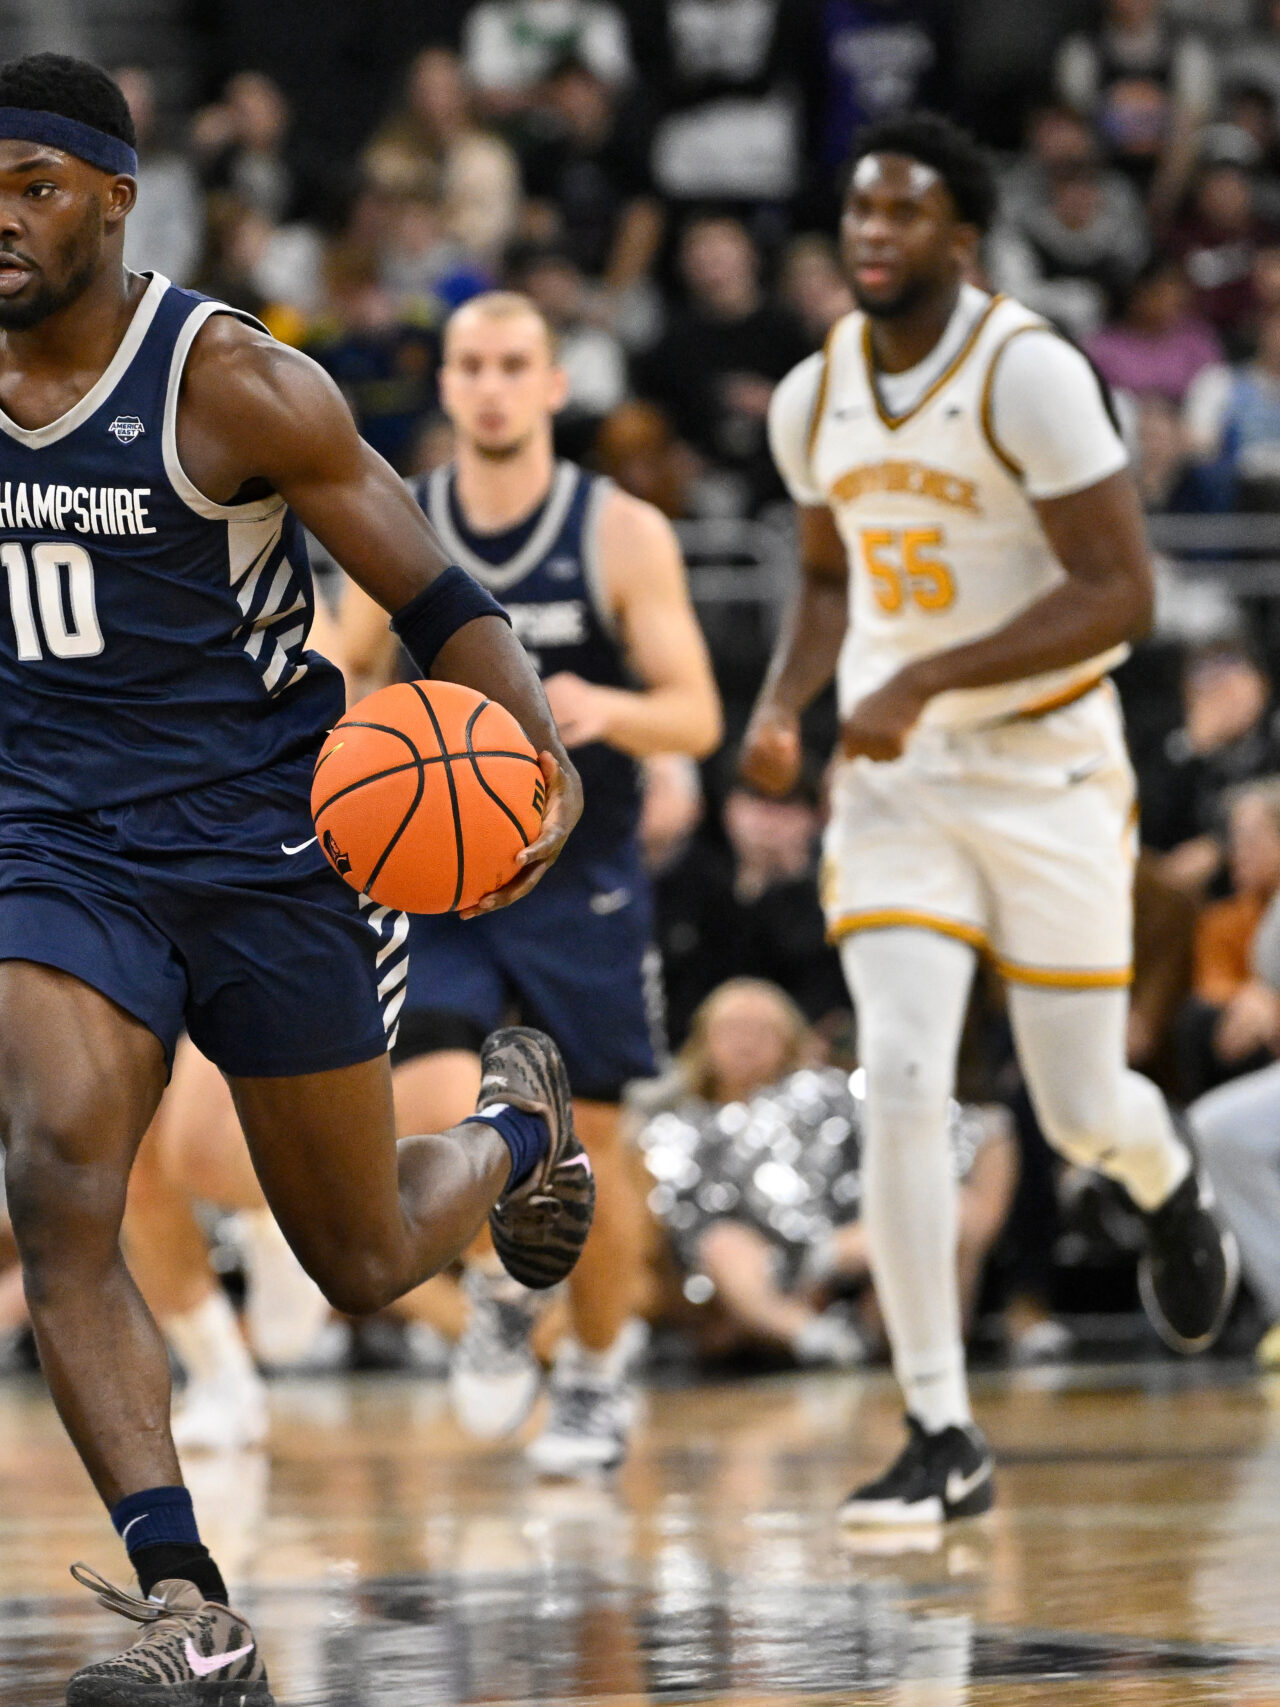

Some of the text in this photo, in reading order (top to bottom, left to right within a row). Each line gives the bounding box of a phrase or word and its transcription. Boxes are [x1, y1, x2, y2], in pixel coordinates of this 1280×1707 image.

[111, 423, 143, 431] AMERICA
[0, 542, 105, 661] 10
[859, 527, 956, 614] 55
